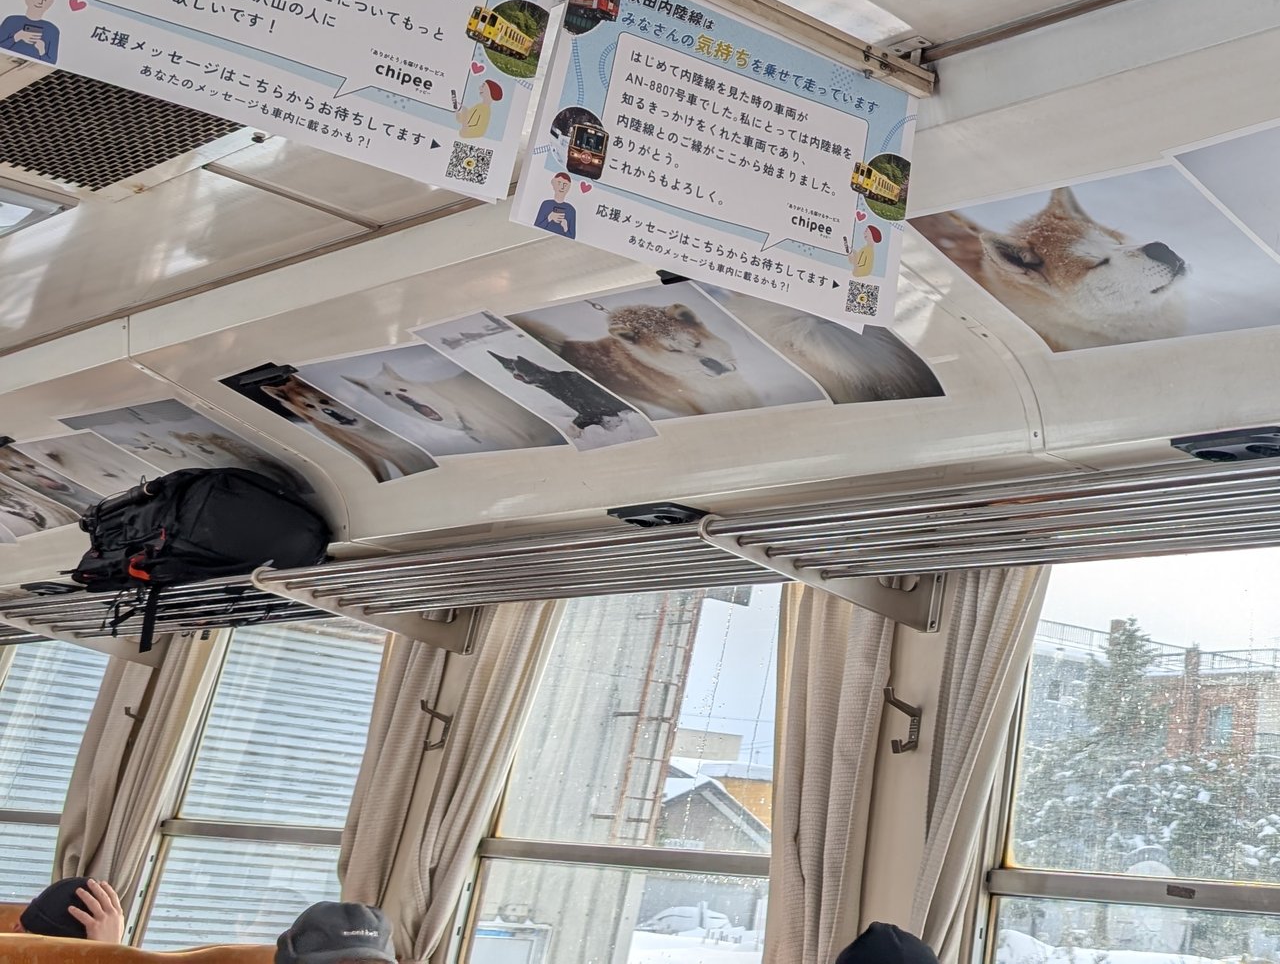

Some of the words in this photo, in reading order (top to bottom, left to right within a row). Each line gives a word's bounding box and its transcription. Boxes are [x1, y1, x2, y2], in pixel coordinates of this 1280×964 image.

[91, 25, 425, 145] 応援メッセージはこちらからお待ちしてます
[375, 64, 433, 91] chipee
[621, 13, 880, 113] みなさんの気持ちを乗せて走っています
[630, 50, 808, 122] はじめて内陸線を見た時の車両が
[612, 136, 680, 169] ありがとう。
[617, 114, 836, 196] 内陸線とのご縁がここから始まりました。
[621, 92, 806, 165] 知るきっかけをくれた車両であり、
[609, 158, 724, 205] これからもよろしく。
[596, 204, 829, 287] 応援メッセージはこちらからお待ちしてます
[791, 216, 833, 235] chipee
